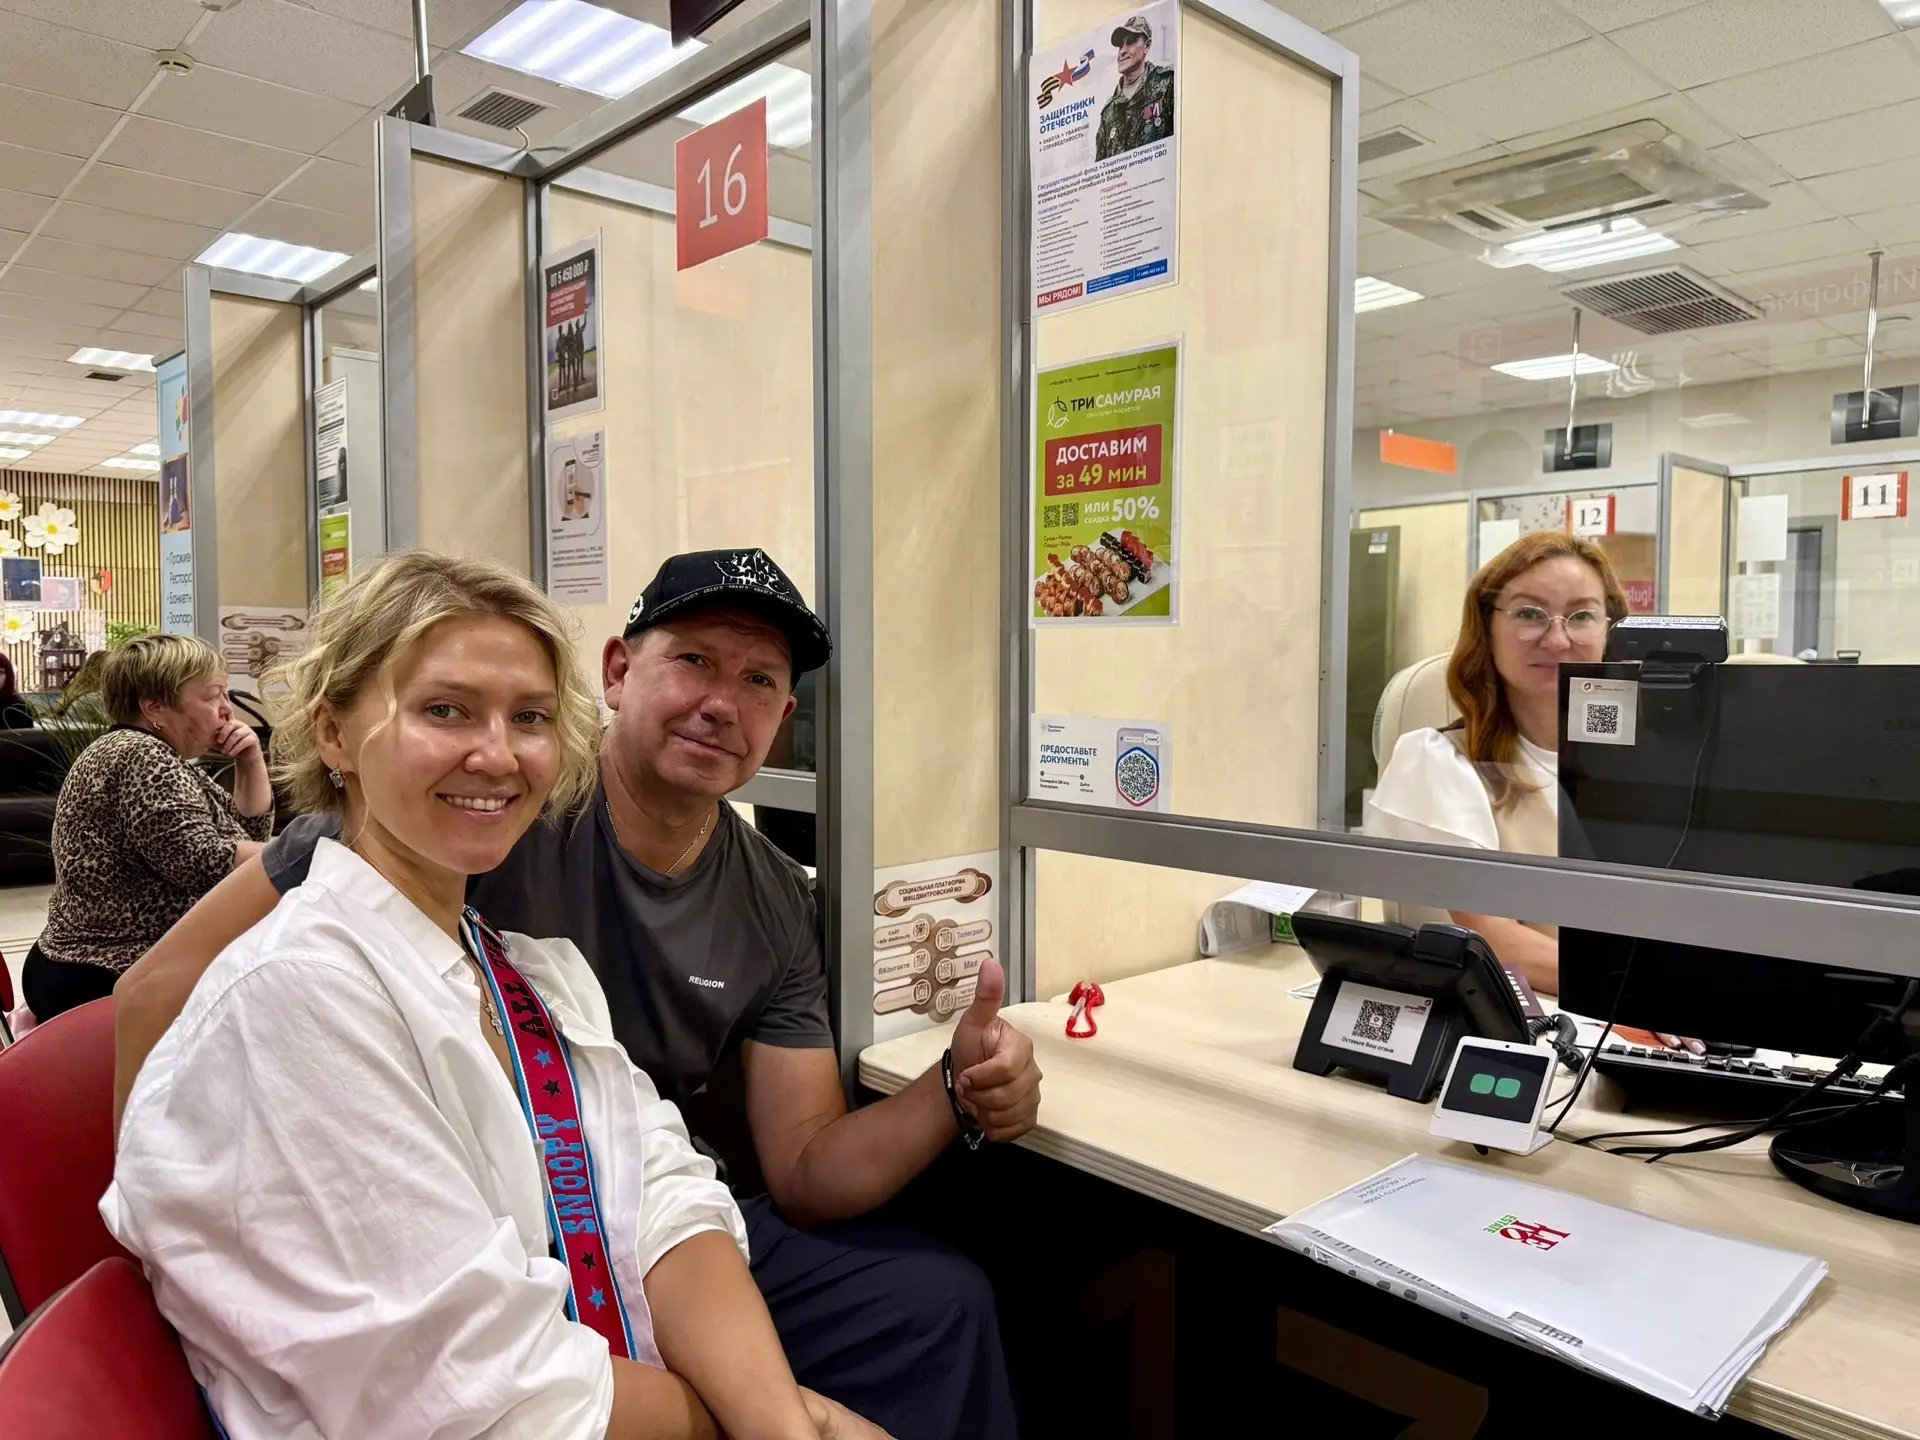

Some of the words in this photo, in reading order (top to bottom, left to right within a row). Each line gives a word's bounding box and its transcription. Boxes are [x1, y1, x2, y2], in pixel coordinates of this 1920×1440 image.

[1039, 96, 1095, 125] ЗАЩИТНИКИ
[1039, 111, 1089, 134] ОТЕЧЕСТВА
[1154, 150, 1167, 159] СВО
[697, 142, 747, 229] 16
[1038, 292, 1051, 305] МЫ
[1052, 284, 1082, 301] РЯДОМ!
[1070, 397, 1095, 412] ТРИ
[1095, 385, 1161, 409] САМУРАЯ
[1056, 436, 1147, 466] ДОСТАВИМ
[1056, 473, 1075, 489] за
[1079, 463, 1103, 486] 49
[1862, 484, 1887, 506] 11
[1111, 496, 1160, 522] 50%
[1580, 508, 1602, 526] 12
[1084, 516, 1110, 524] скидка
[169, 611, 192, 628] Зоопар
[1040, 744, 1097, 757] ПРЕДОСТАВЬТЕ
[1040, 754, 1089, 767] ДОКУМЕНТЫ
[898, 883, 934, 896] СОЦИАЛЬНАЯ
[934, 878, 966, 889] ПЛАТФОРМА
[916, 886, 954, 901] ДМИТРОВСКИЙ
[956, 928, 984, 939] Телеграм
[878, 962, 910, 975] ВКонтакте
[963, 959, 978, 970] Max
[688, 975, 725, 989] RELIGION
[1341, 1035, 1366, 1048] Оставьте
[1366, 1040, 1377, 1050] Ваш
[1377, 1044, 1394, 1054] отзыв
[537, 1114, 598, 1234] SNOOPY
[1483, 1214, 1518, 1234] ESTATE
